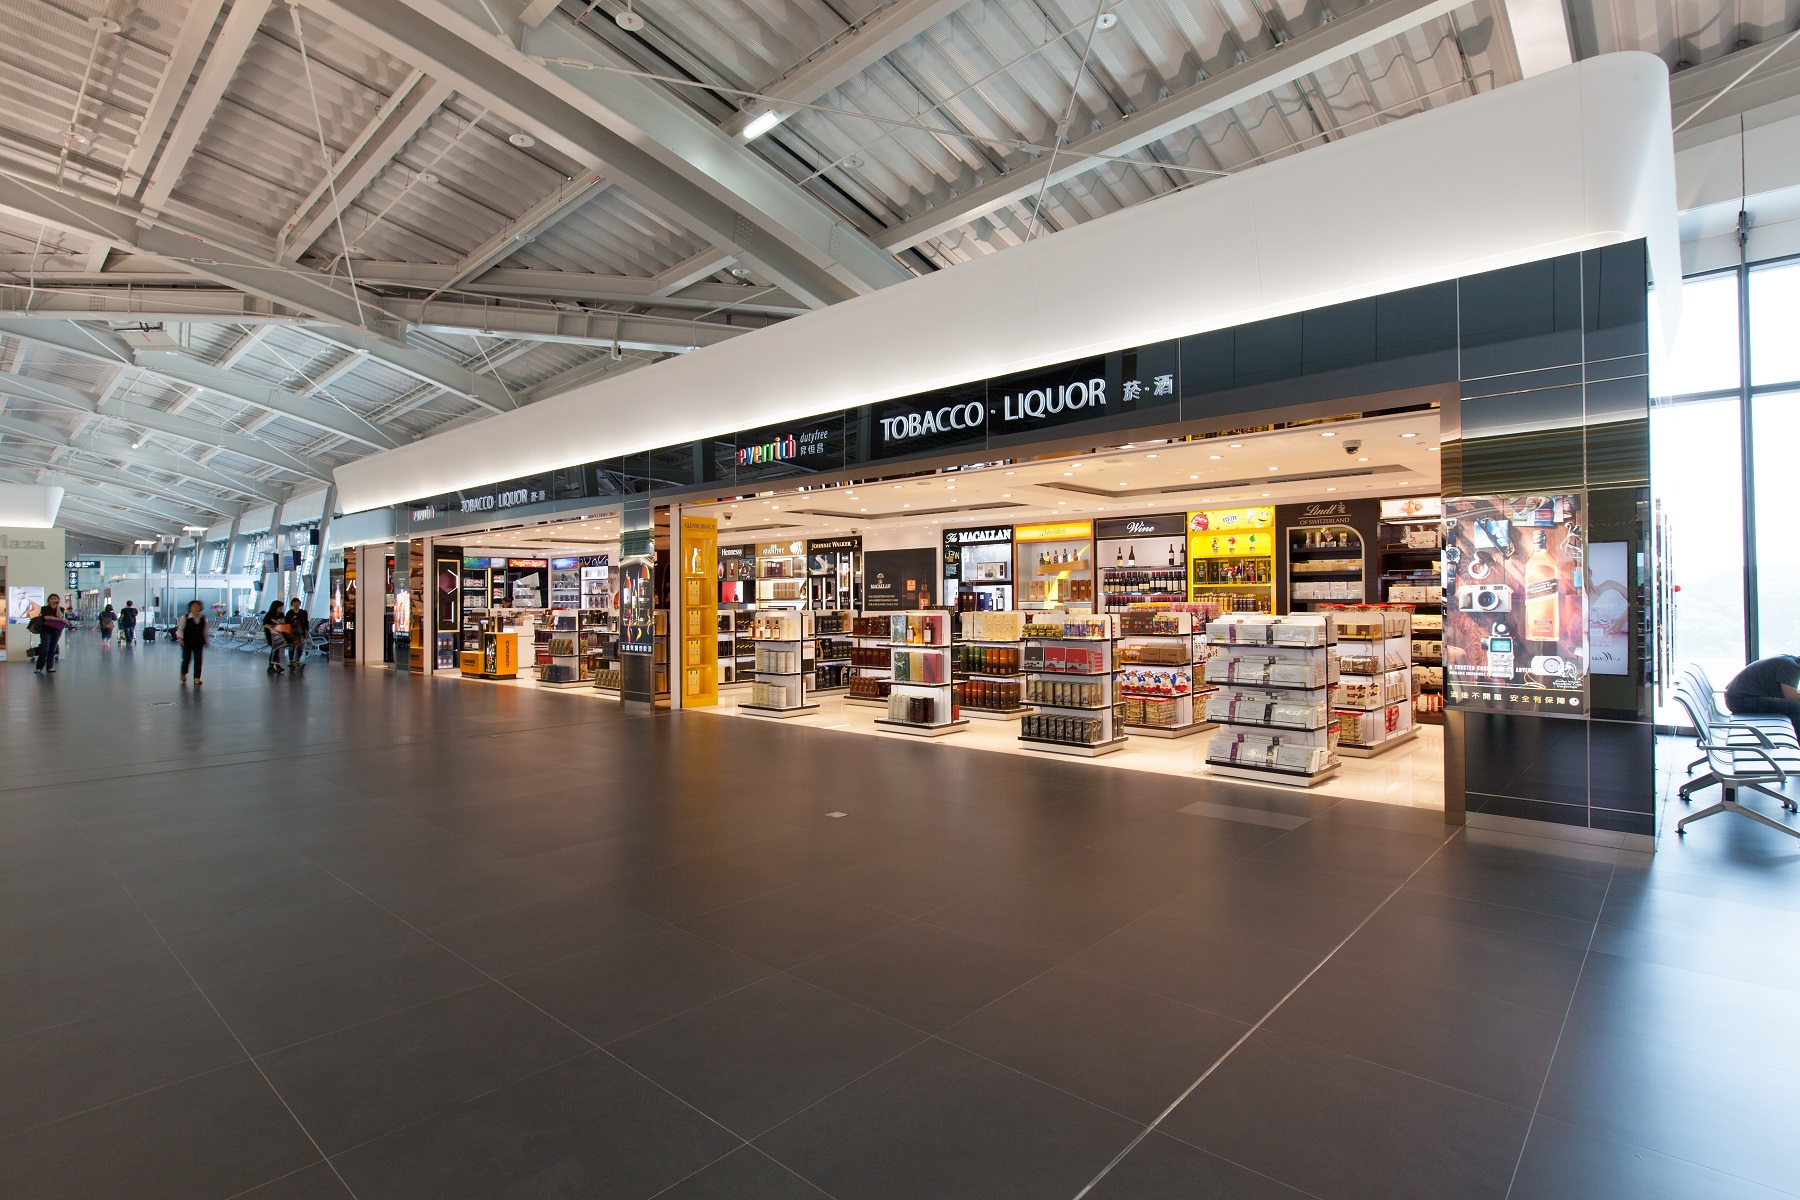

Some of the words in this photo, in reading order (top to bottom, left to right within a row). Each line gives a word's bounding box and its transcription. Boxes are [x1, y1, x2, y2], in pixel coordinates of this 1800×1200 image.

[880, 401, 985, 441] TOBACCO
[1004, 378, 1107, 421] LIQUOR
[800, 429, 829, 444] dutyfree
[738, 434, 797, 466] everrich
[498, 488, 529, 507] LIQUOR
[1303, 504, 1338, 516] Lindt
[1126, 521, 1156, 534] Wine
[1308, 516, 1350, 525] SWITZERLAND
[958, 528, 1012, 543] MACALLAN
[721, 547, 744, 557] Hennessy
[1509, 694, 1566, 704] 安全有保障
